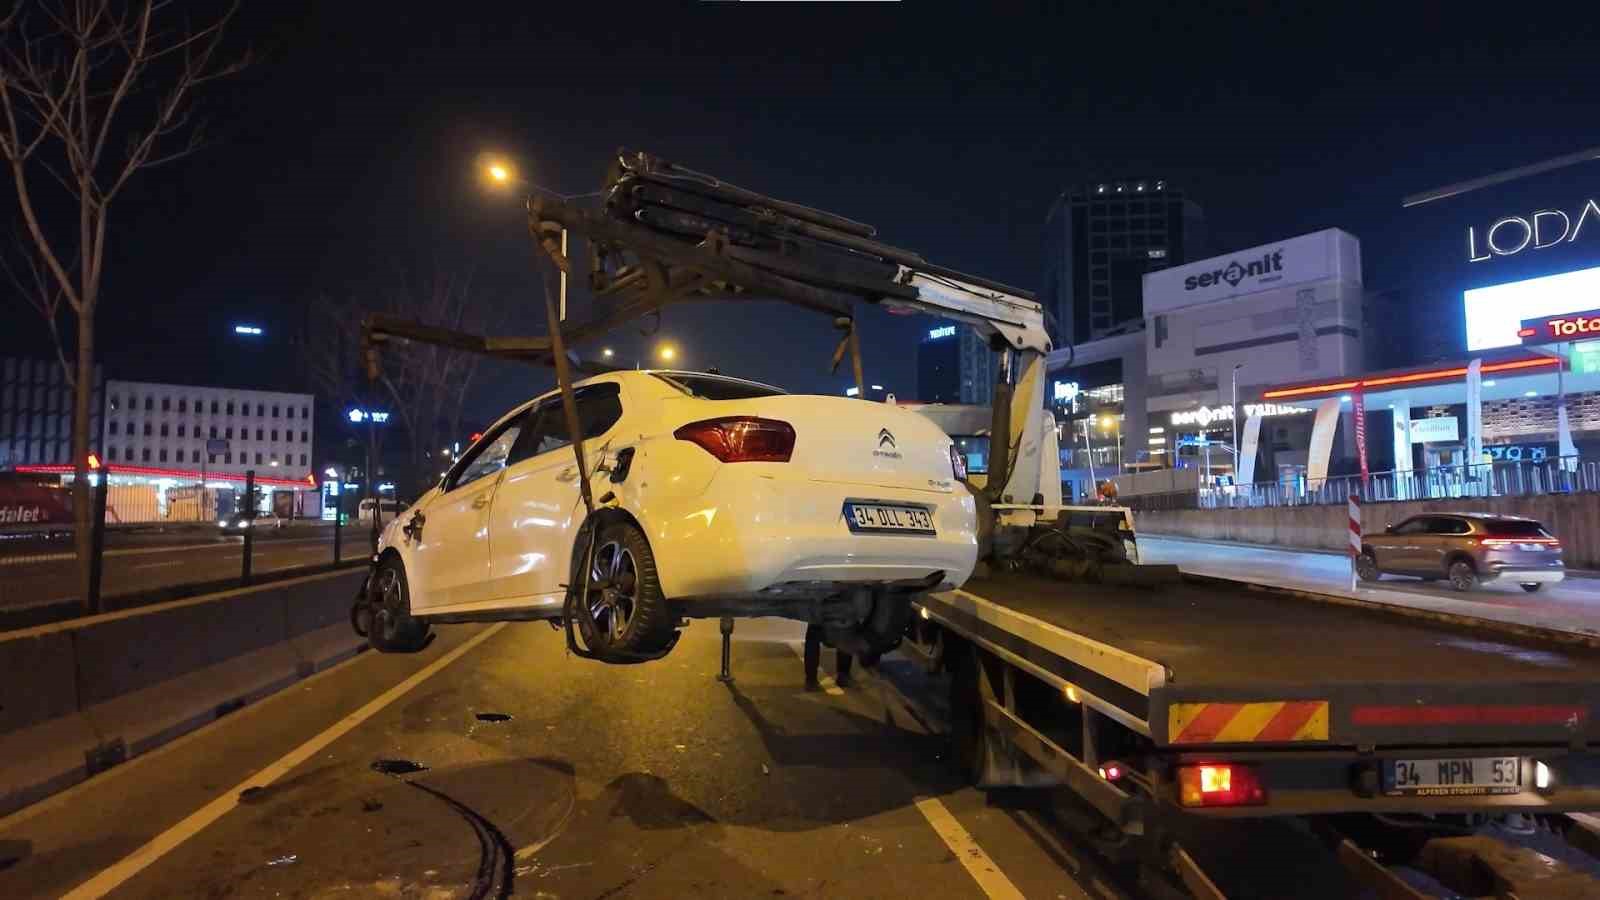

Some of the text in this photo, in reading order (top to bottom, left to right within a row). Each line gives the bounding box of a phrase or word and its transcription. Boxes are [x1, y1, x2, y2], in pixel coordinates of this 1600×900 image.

[1184, 251, 1283, 291] seranit
[855, 507, 930, 528] 34 DLL 343
[1397, 759, 1516, 786] 34 MPN 53
